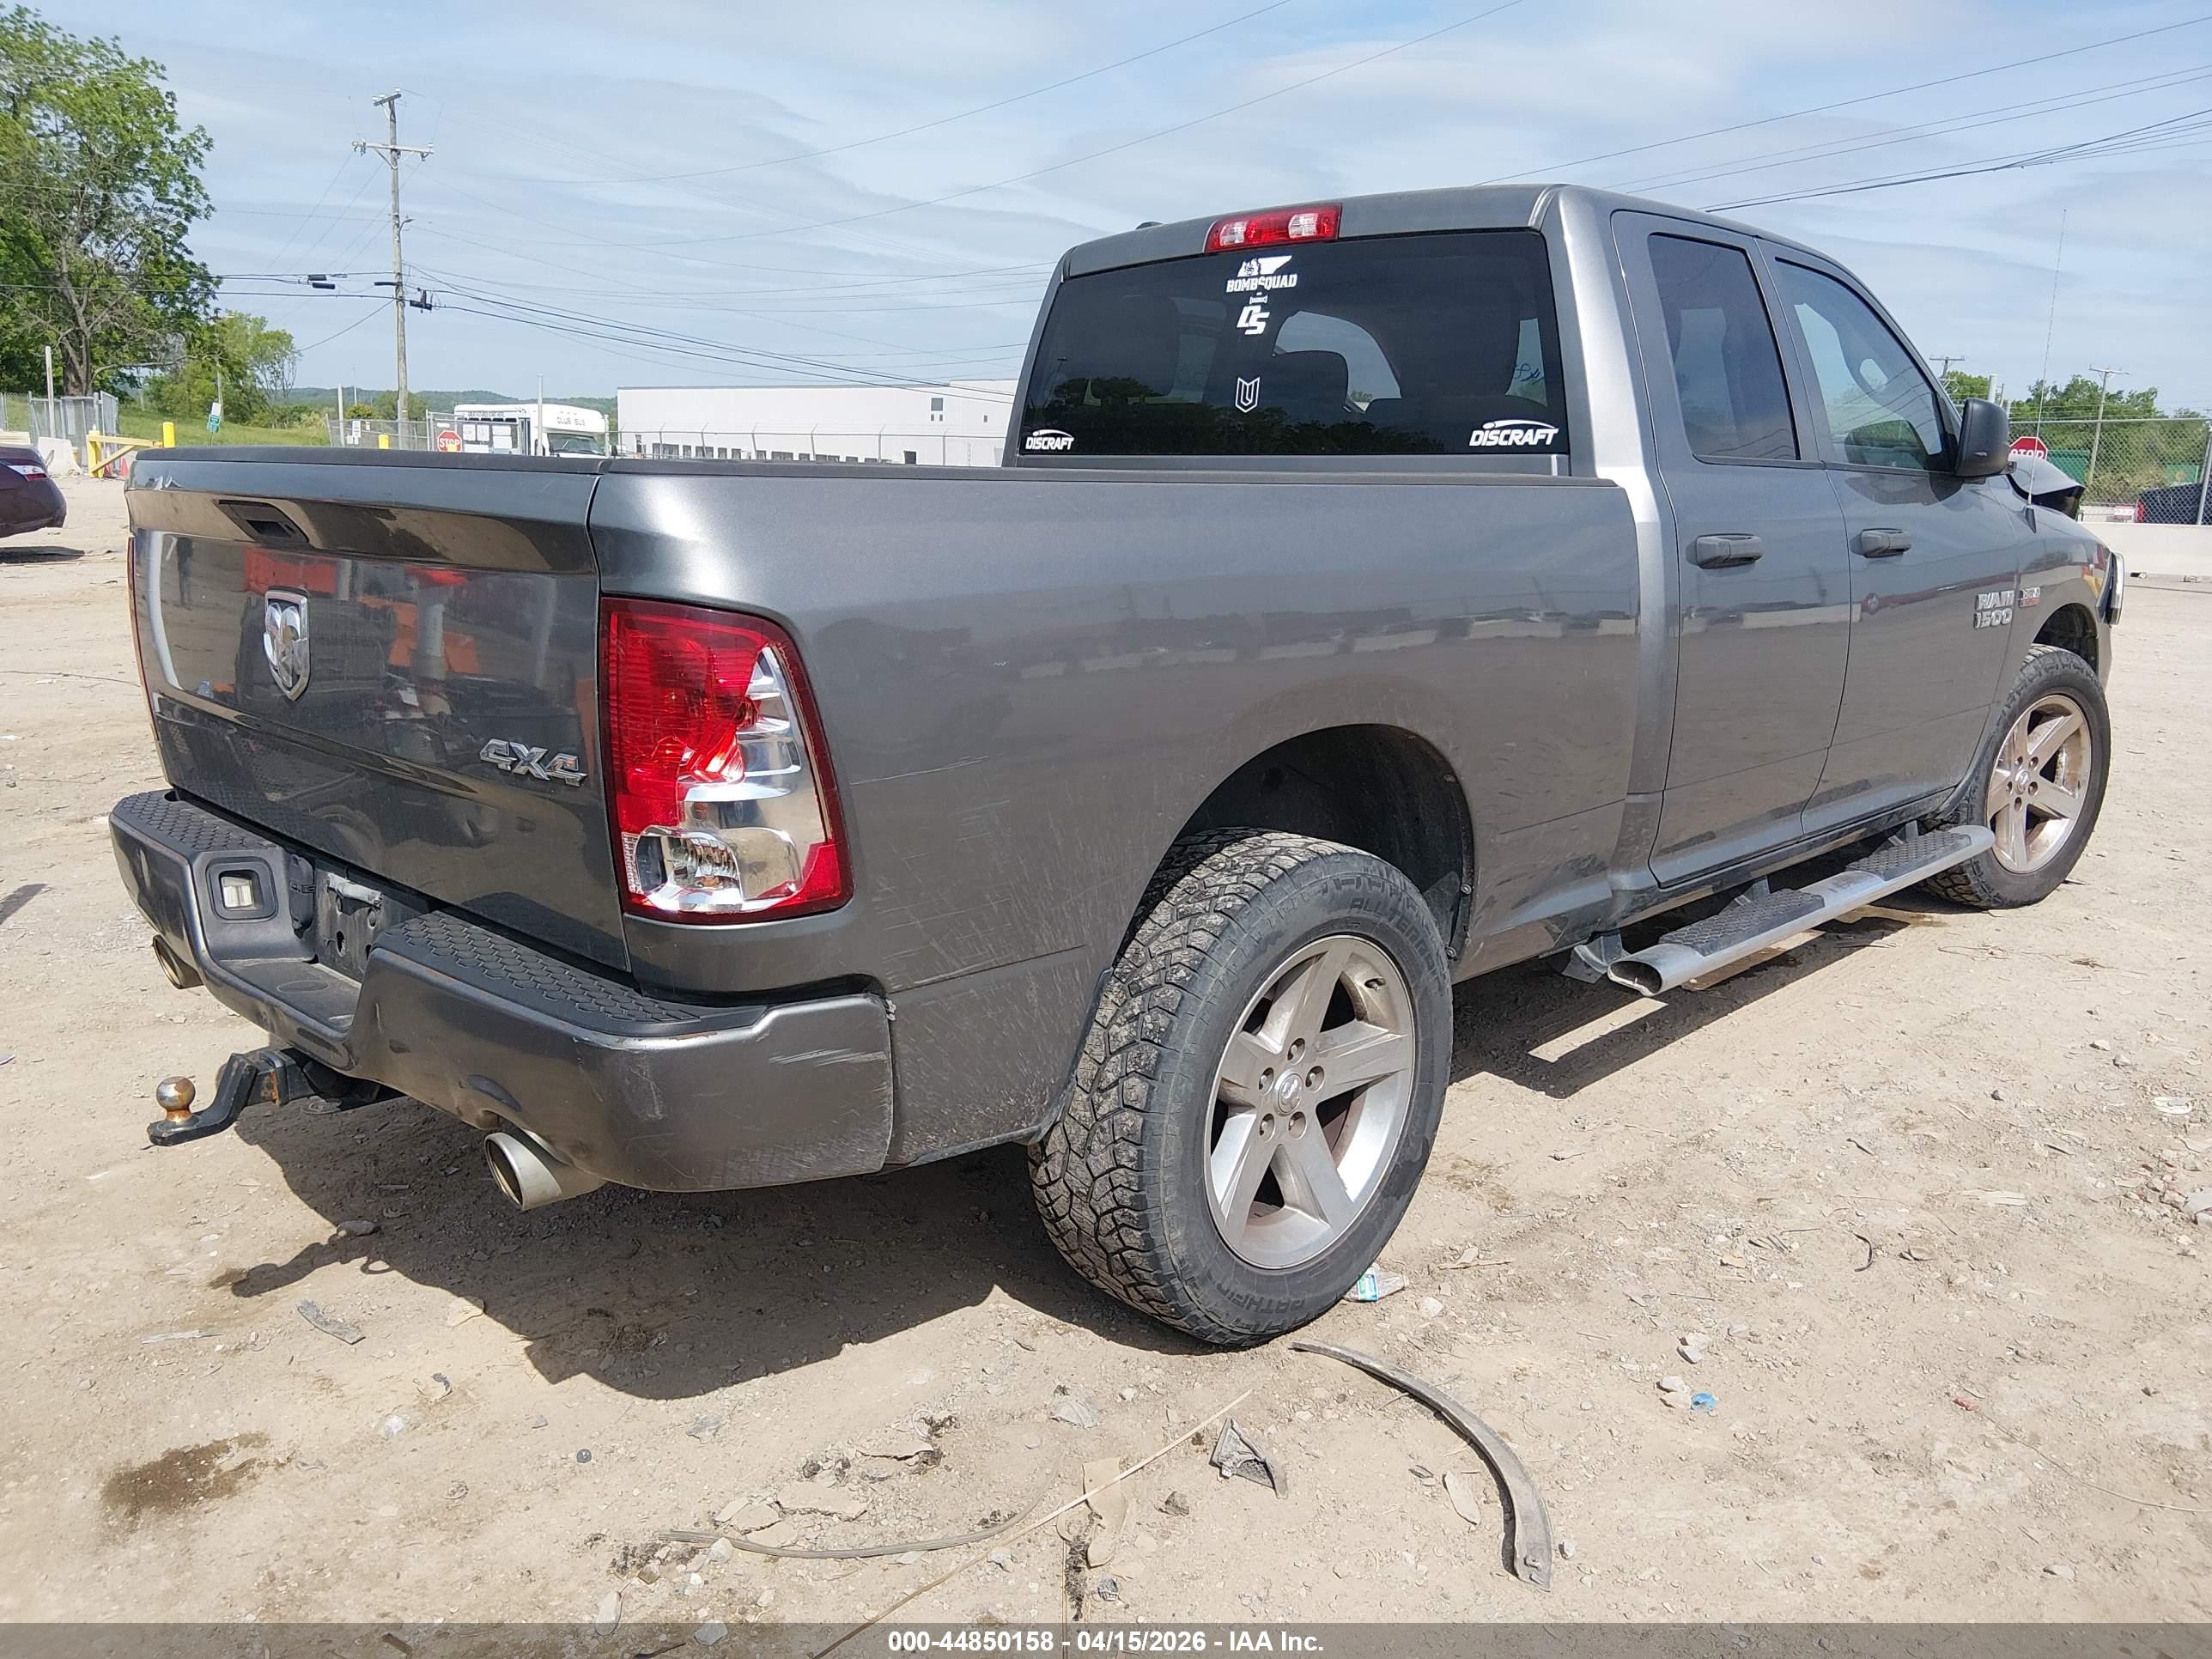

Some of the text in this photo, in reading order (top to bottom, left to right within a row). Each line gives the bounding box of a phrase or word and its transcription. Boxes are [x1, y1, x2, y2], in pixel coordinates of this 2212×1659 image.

[1226, 274, 1298, 293] BOMBSQUAD
[1025, 436, 1074, 450] DISCRAFT
[1468, 428, 1559, 447] DISCRAFT
[1976, 590, 2014, 611] RAM
[1974, 608, 2013, 629] 1500
